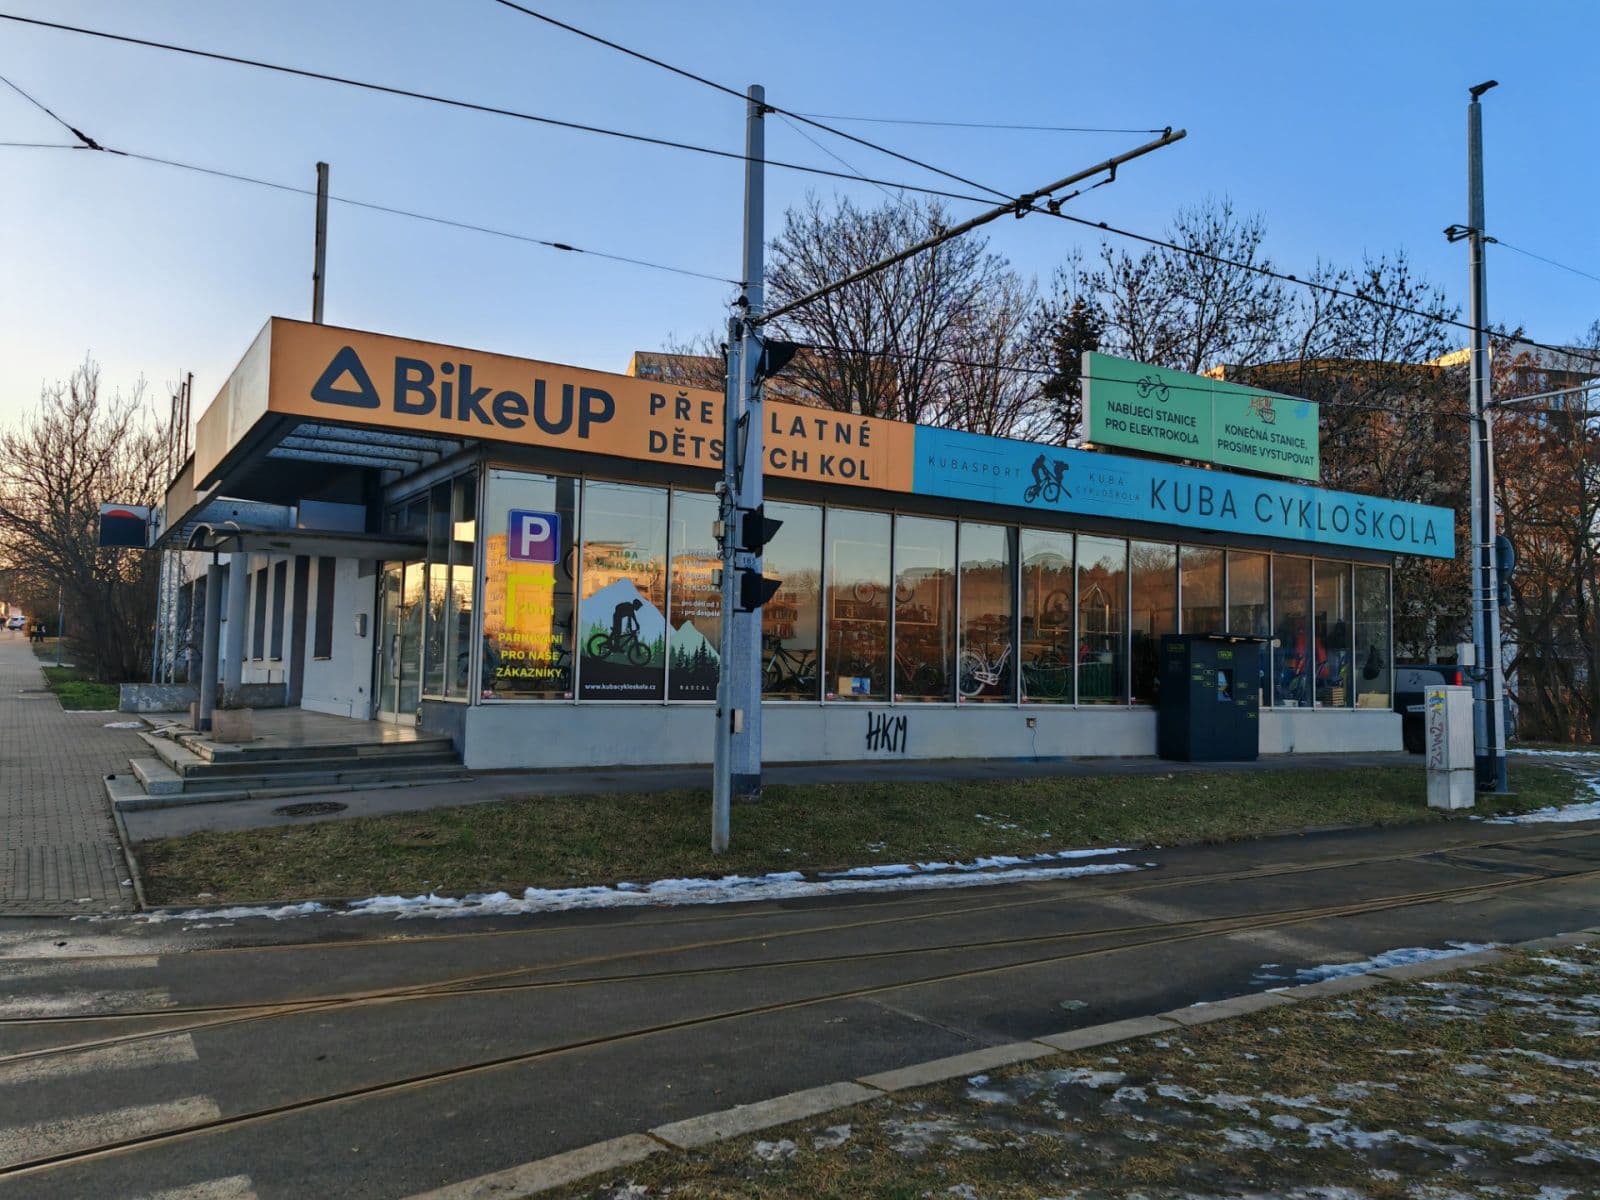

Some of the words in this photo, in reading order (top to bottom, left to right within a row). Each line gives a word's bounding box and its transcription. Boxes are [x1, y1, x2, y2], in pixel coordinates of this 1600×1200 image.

[393, 356, 616, 439] BikeUP
[650, 390, 871, 447] PŘELATNÉ
[1107, 401, 1154, 419] NABÍJECÍ
[1156, 411, 1197, 427] STANICE
[1105, 418, 1127, 431] PRO
[1129, 422, 1199, 444] ELEKTROKOLA
[1225, 423, 1269, 441] KONEČNÁ
[649, 427, 808, 473] DĚTSCH
[820, 455, 870, 480] KOL
[1217, 438, 1258, 455] PROSÍME
[1259, 446, 1314, 466] VYSTUPOVAT
[929, 455, 1021, 479] KUBASPORT
[1089, 471, 1124, 486] KUBA
[1151, 478, 1237, 519] KUBA
[1255, 493, 1437, 546] CYKLOŠKOLA
[521, 516, 550, 556] P
[501, 650, 525, 660] PRO
[529, 648, 559, 661] NAŠE
[496, 665, 562, 678] ZÁKAZNÍKY
[866, 711, 907, 752] HKM
